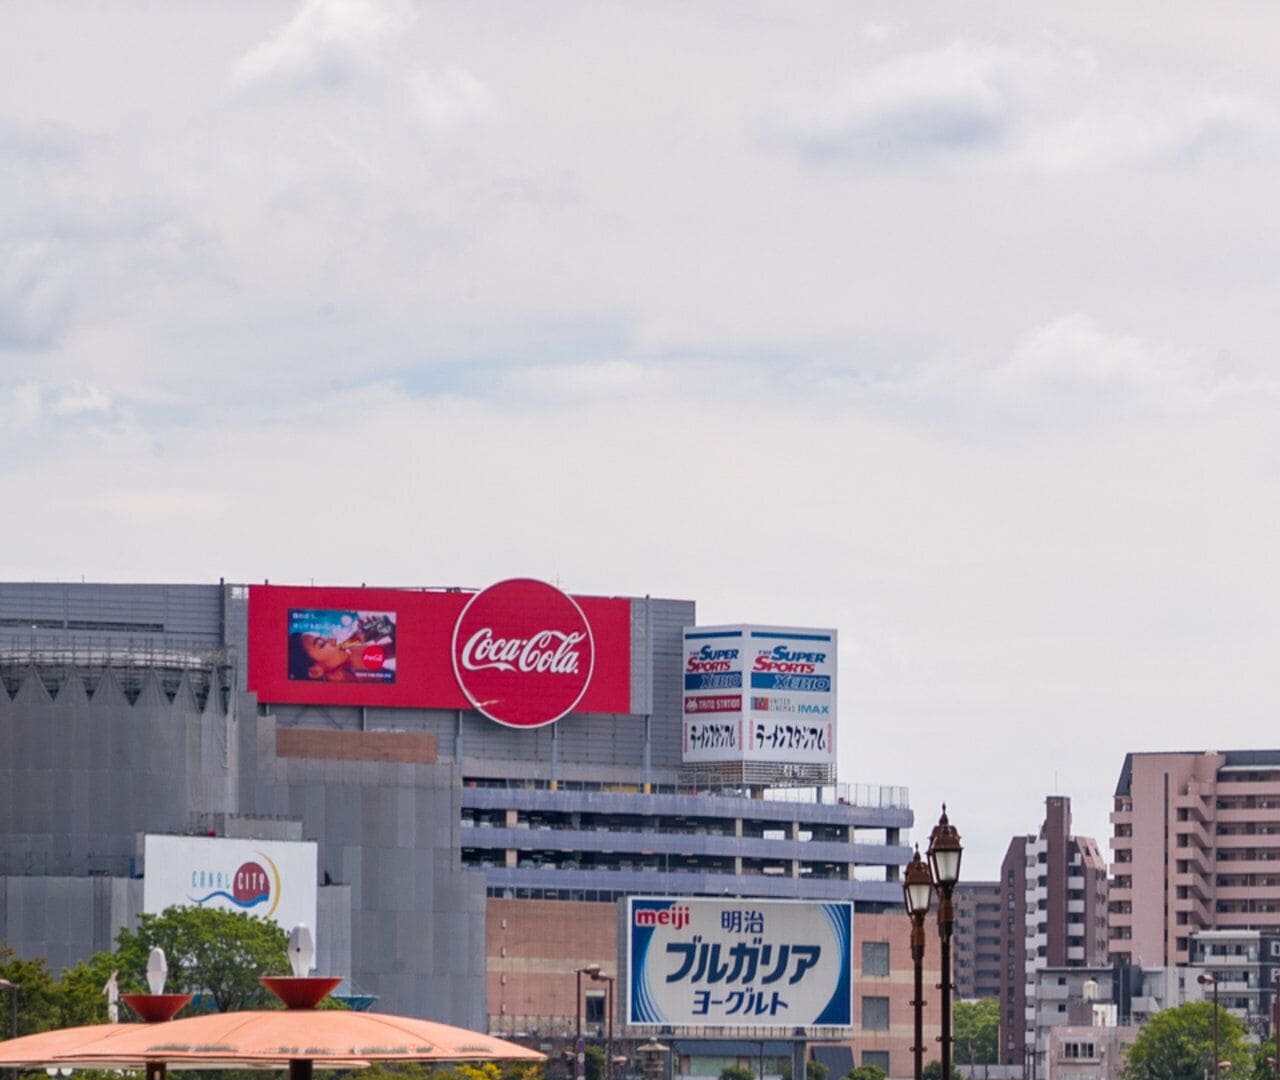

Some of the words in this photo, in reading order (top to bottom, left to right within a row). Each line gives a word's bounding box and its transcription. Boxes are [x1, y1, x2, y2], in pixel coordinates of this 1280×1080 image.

[461, 627, 587, 675] Coca-Cola
[699, 645, 740, 661] SUPER
[771, 645, 827, 664] SUPER
[685, 656, 731, 673] SPORTS
[753, 656, 816, 674] SPORTS
[700, 672, 743, 689] XEBIO
[773, 674, 830, 691] XEBIO
[698, 699, 716, 710] TAITO
[716, 698, 741, 710] STATION
[798, 704, 829, 714] IMAX
[690, 724, 736, 750] ラーメンスタジアム
[756, 724, 826, 751] ラーメンスタジアム
[237, 872, 265, 891] CITY
[636, 907, 690, 931] meiji
[721, 910, 765, 934] 明治
[666, 935, 822, 985] ブルガリア
[691, 987, 789, 1016] ヨーグルト
